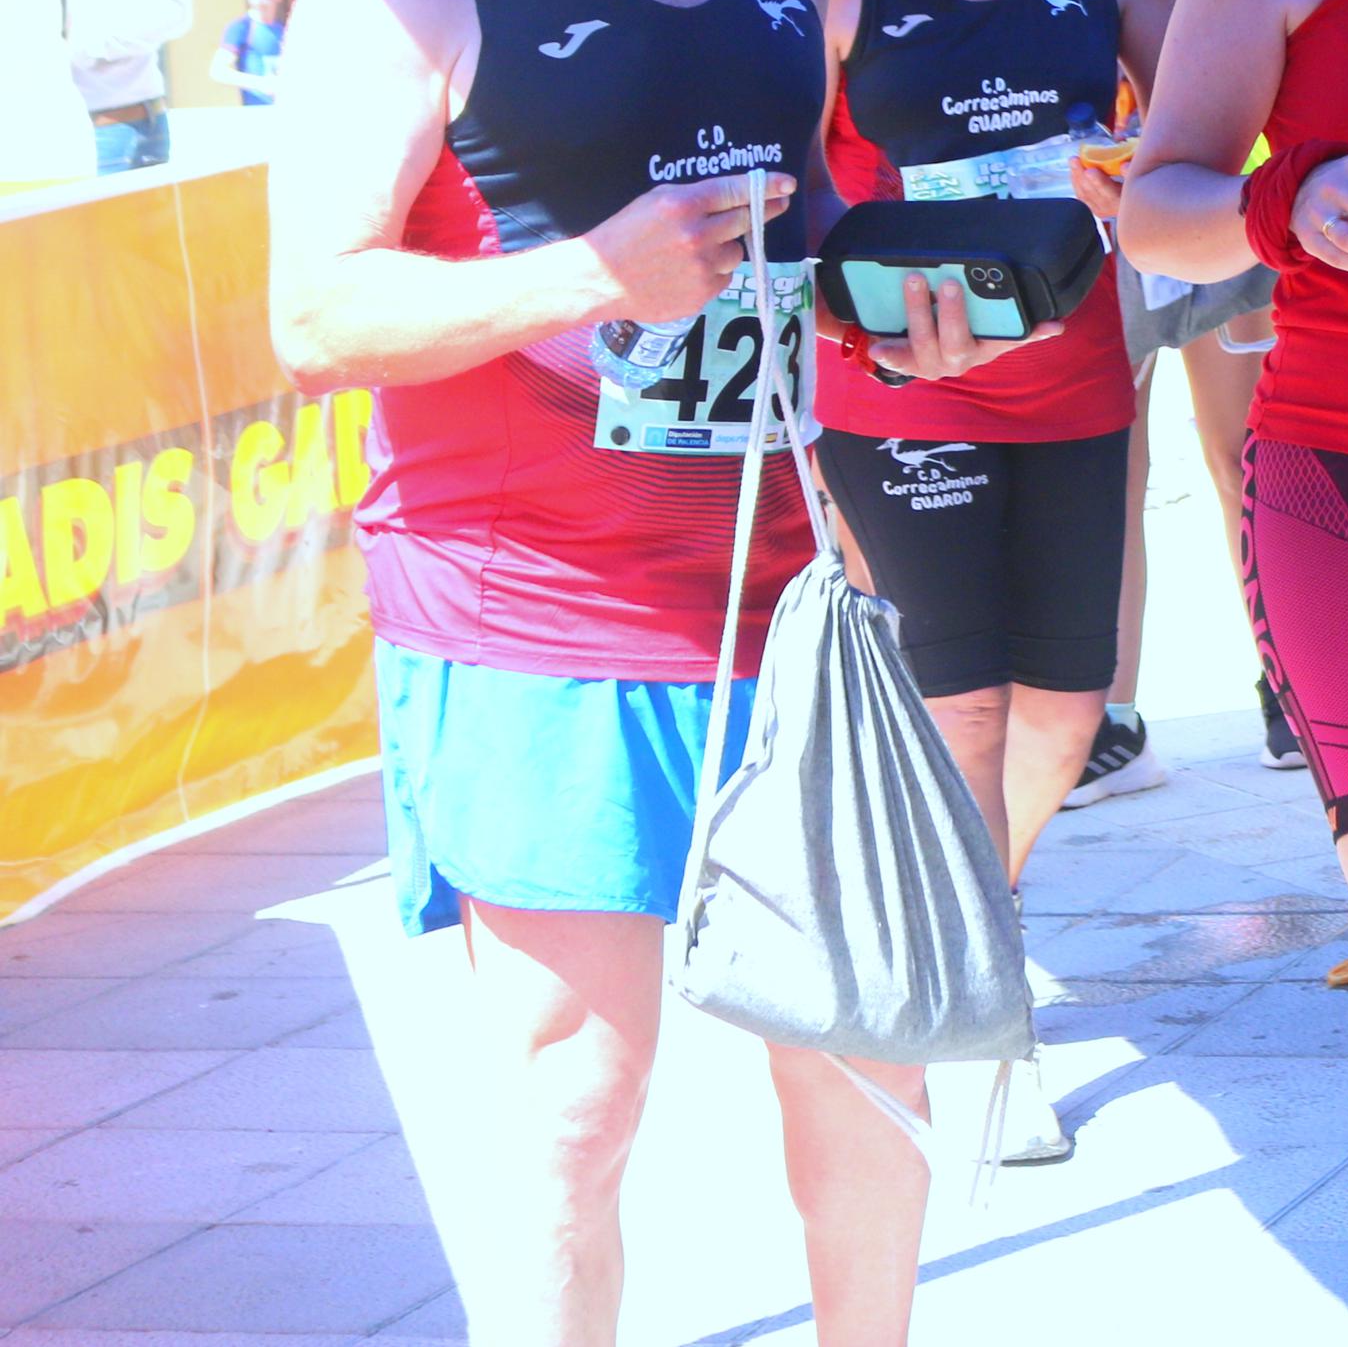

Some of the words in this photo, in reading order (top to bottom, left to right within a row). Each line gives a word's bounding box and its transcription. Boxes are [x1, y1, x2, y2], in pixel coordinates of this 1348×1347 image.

[982, 77, 1012, 94] C.D.
[941, 90, 1060, 115] Correcaminos
[968, 110, 1034, 134] GUARDO
[697, 125, 733, 150] C.D.
[649, 143, 783, 181] Correcaminos
[640, 313, 803, 423] 423
[882, 474, 989, 496] Correcaminos
[911, 490, 973, 511] GUARDO
